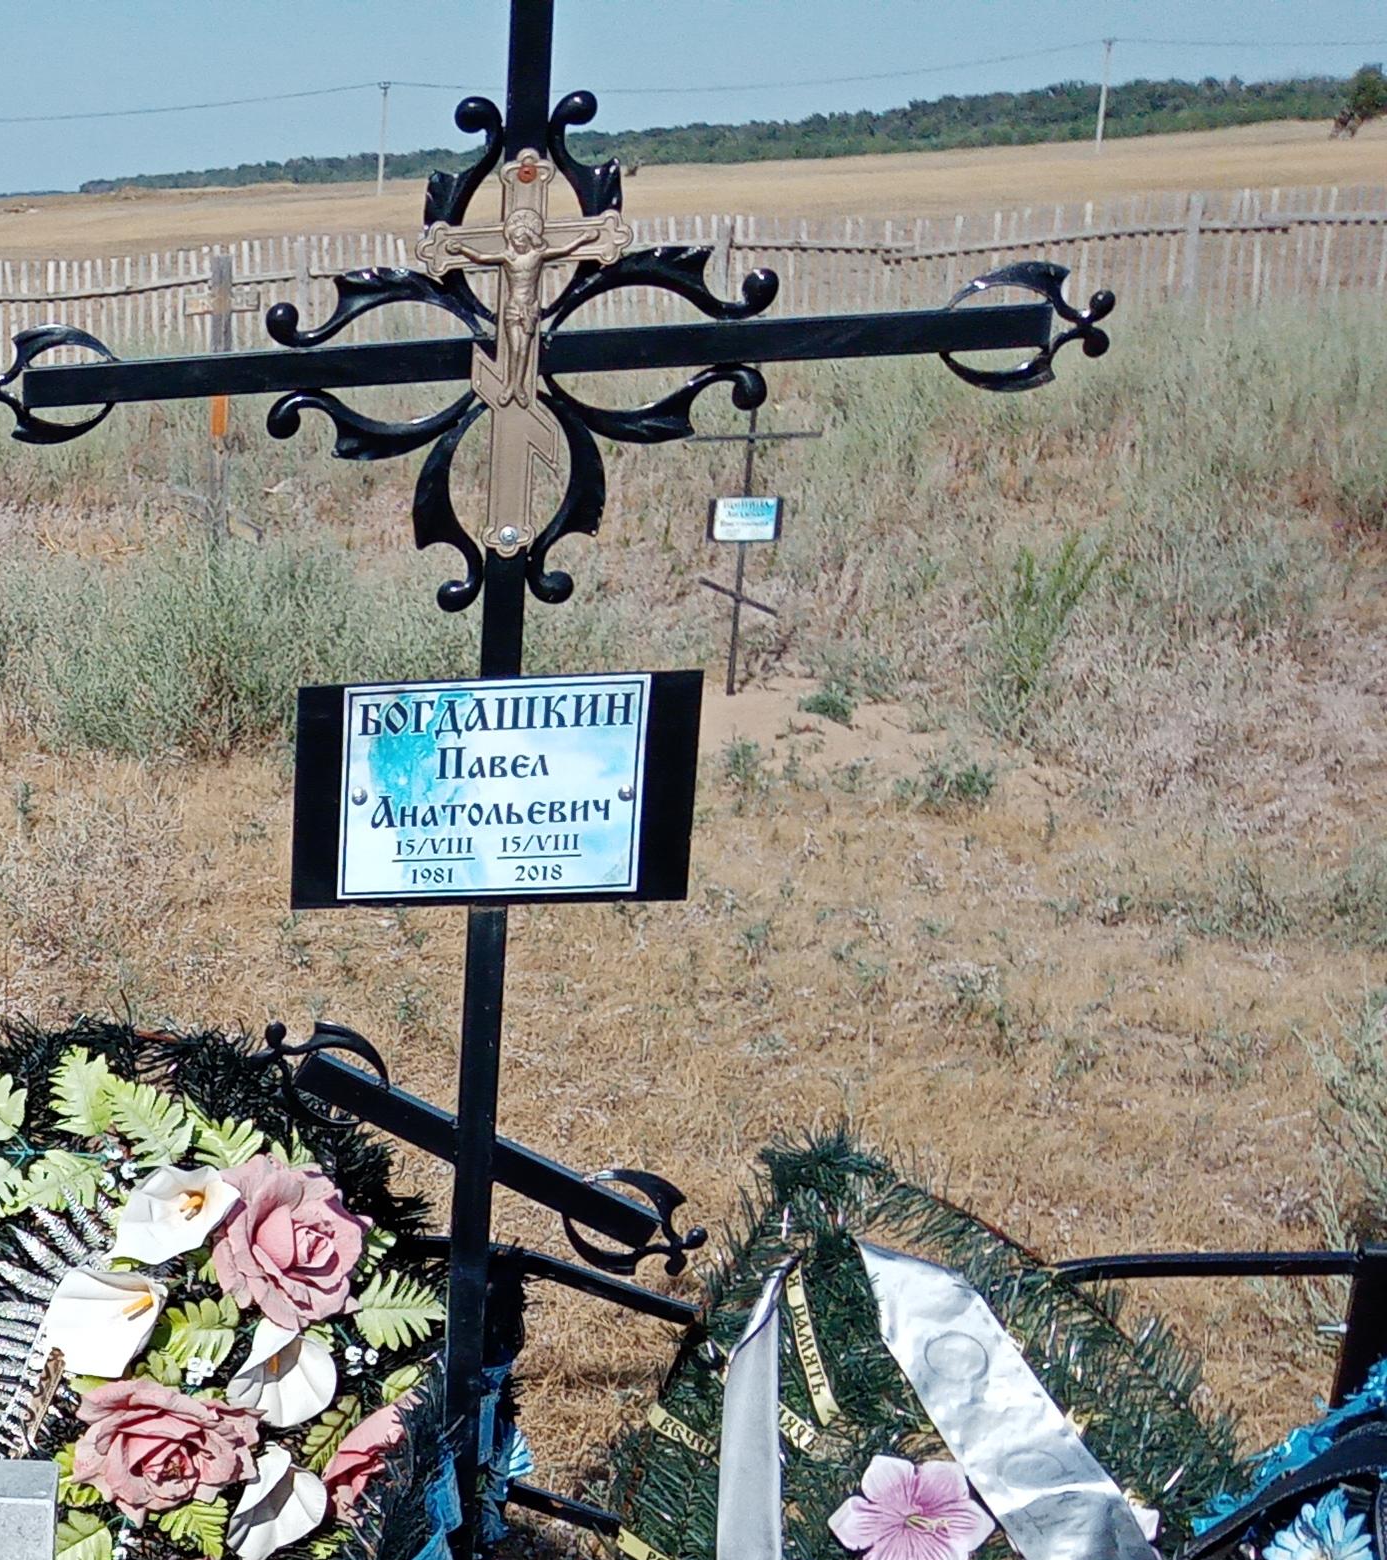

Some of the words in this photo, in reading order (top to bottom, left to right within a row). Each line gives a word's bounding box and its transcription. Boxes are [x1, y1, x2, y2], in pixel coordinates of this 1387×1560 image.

[358, 692, 636, 739] БОГДАШКИН
[436, 747, 549, 780] Павел
[370, 796, 611, 828] Анатольевич
[395, 836, 474, 857] 15/VIII
[501, 833, 580, 853] 15/VIII
[411, 866, 453, 885] 1981
[515, 863, 563, 882] 2018
[658, 1416, 712, 1455] ВЕЧН
